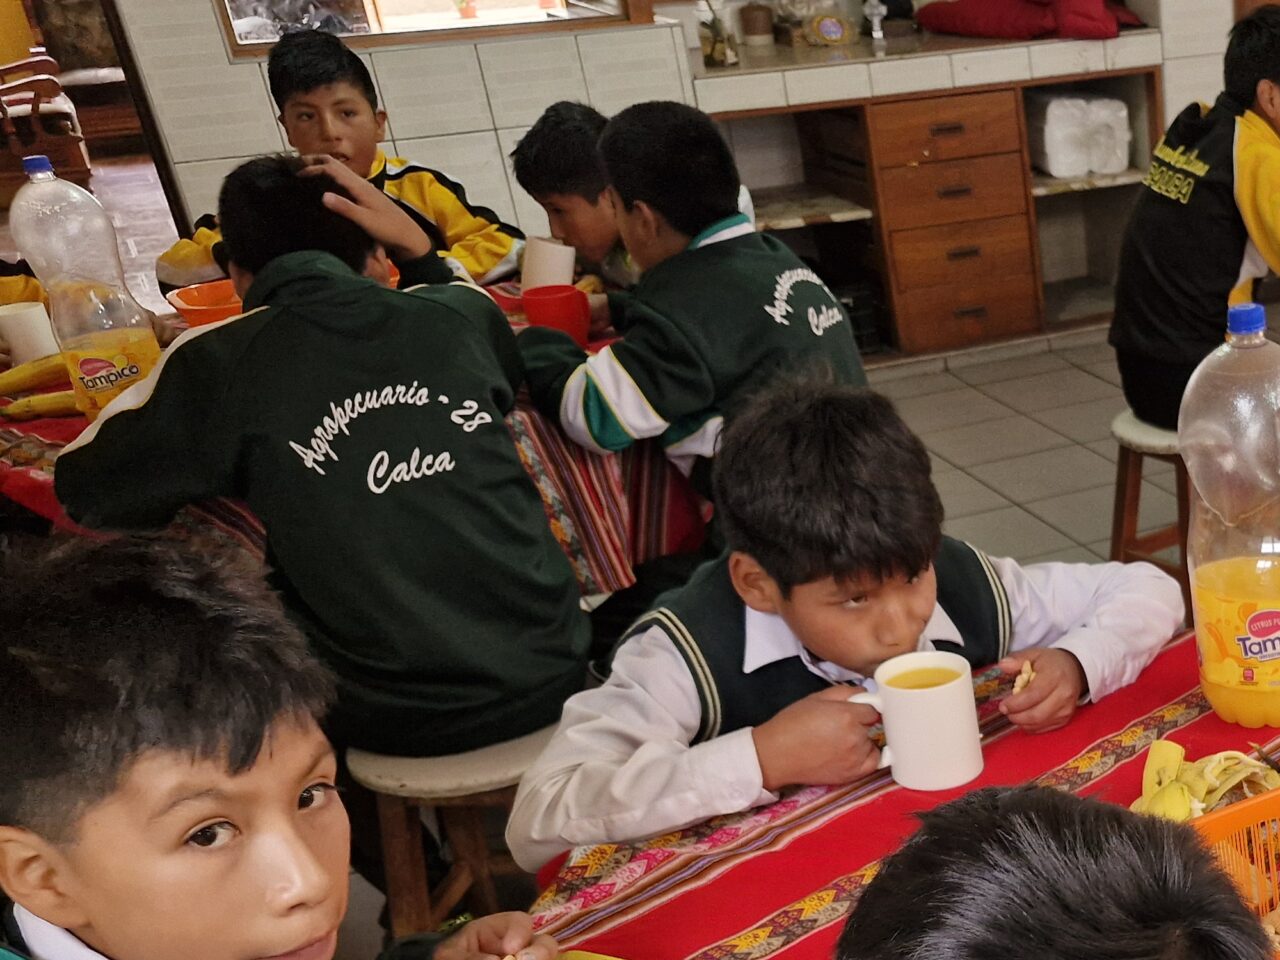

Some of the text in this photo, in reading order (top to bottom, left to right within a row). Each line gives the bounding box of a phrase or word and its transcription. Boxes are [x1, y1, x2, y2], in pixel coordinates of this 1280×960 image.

[807, 304, 843, 336] Calca
[78, 364, 139, 390] Tampico
[289, 380, 430, 475] Agropecuario
[450, 400, 493, 433] 28
[366, 446, 456, 494] Calca
[1250, 619, 1273, 632] CITRUS
